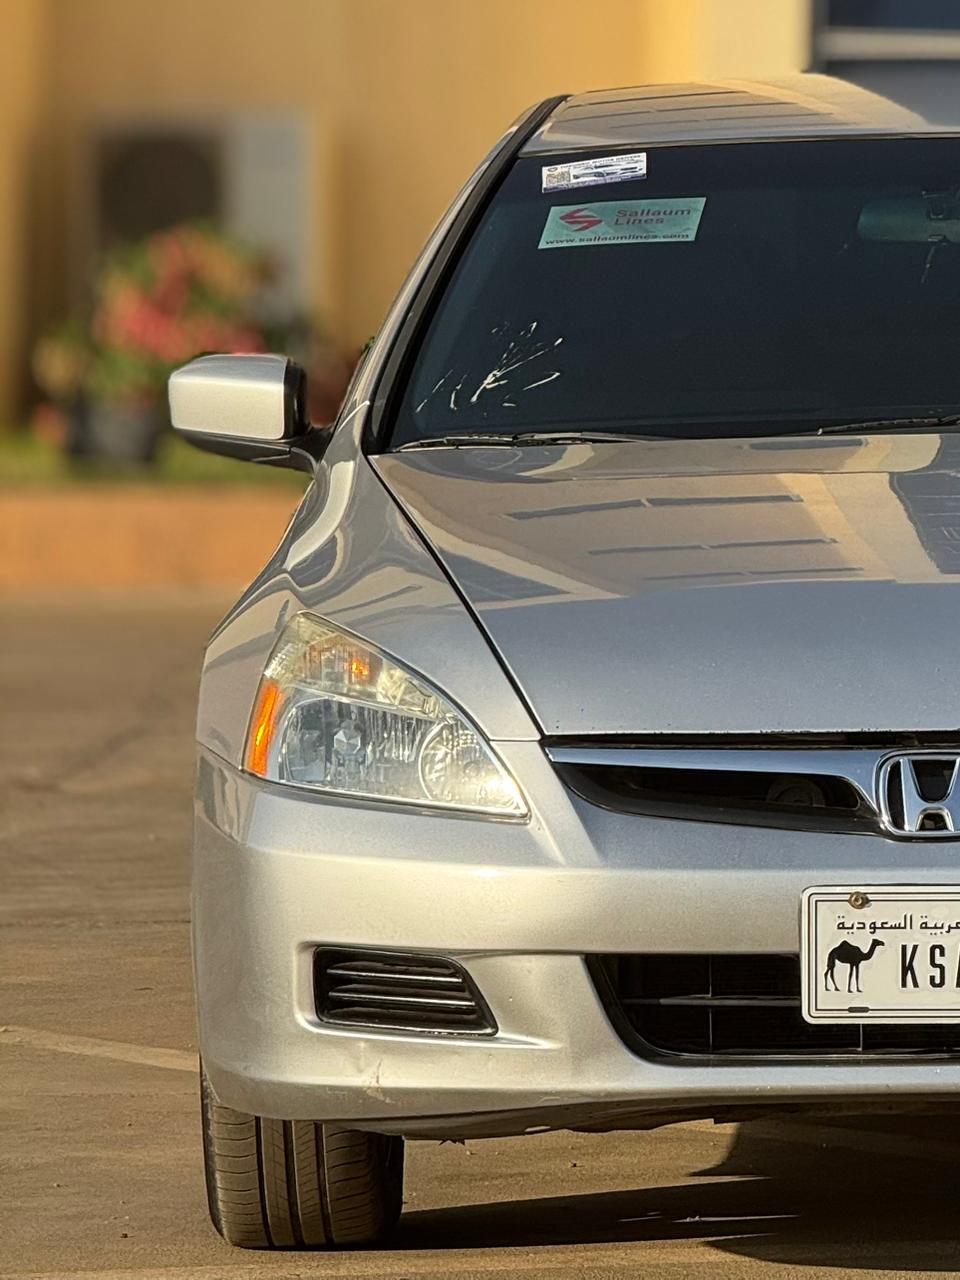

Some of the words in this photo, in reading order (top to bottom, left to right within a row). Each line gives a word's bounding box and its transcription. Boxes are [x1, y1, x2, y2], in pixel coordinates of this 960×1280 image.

[615, 208, 691, 218] Sallaum
[614, 217, 665, 226] Lines
[836, 914, 913, 935] السعودية
